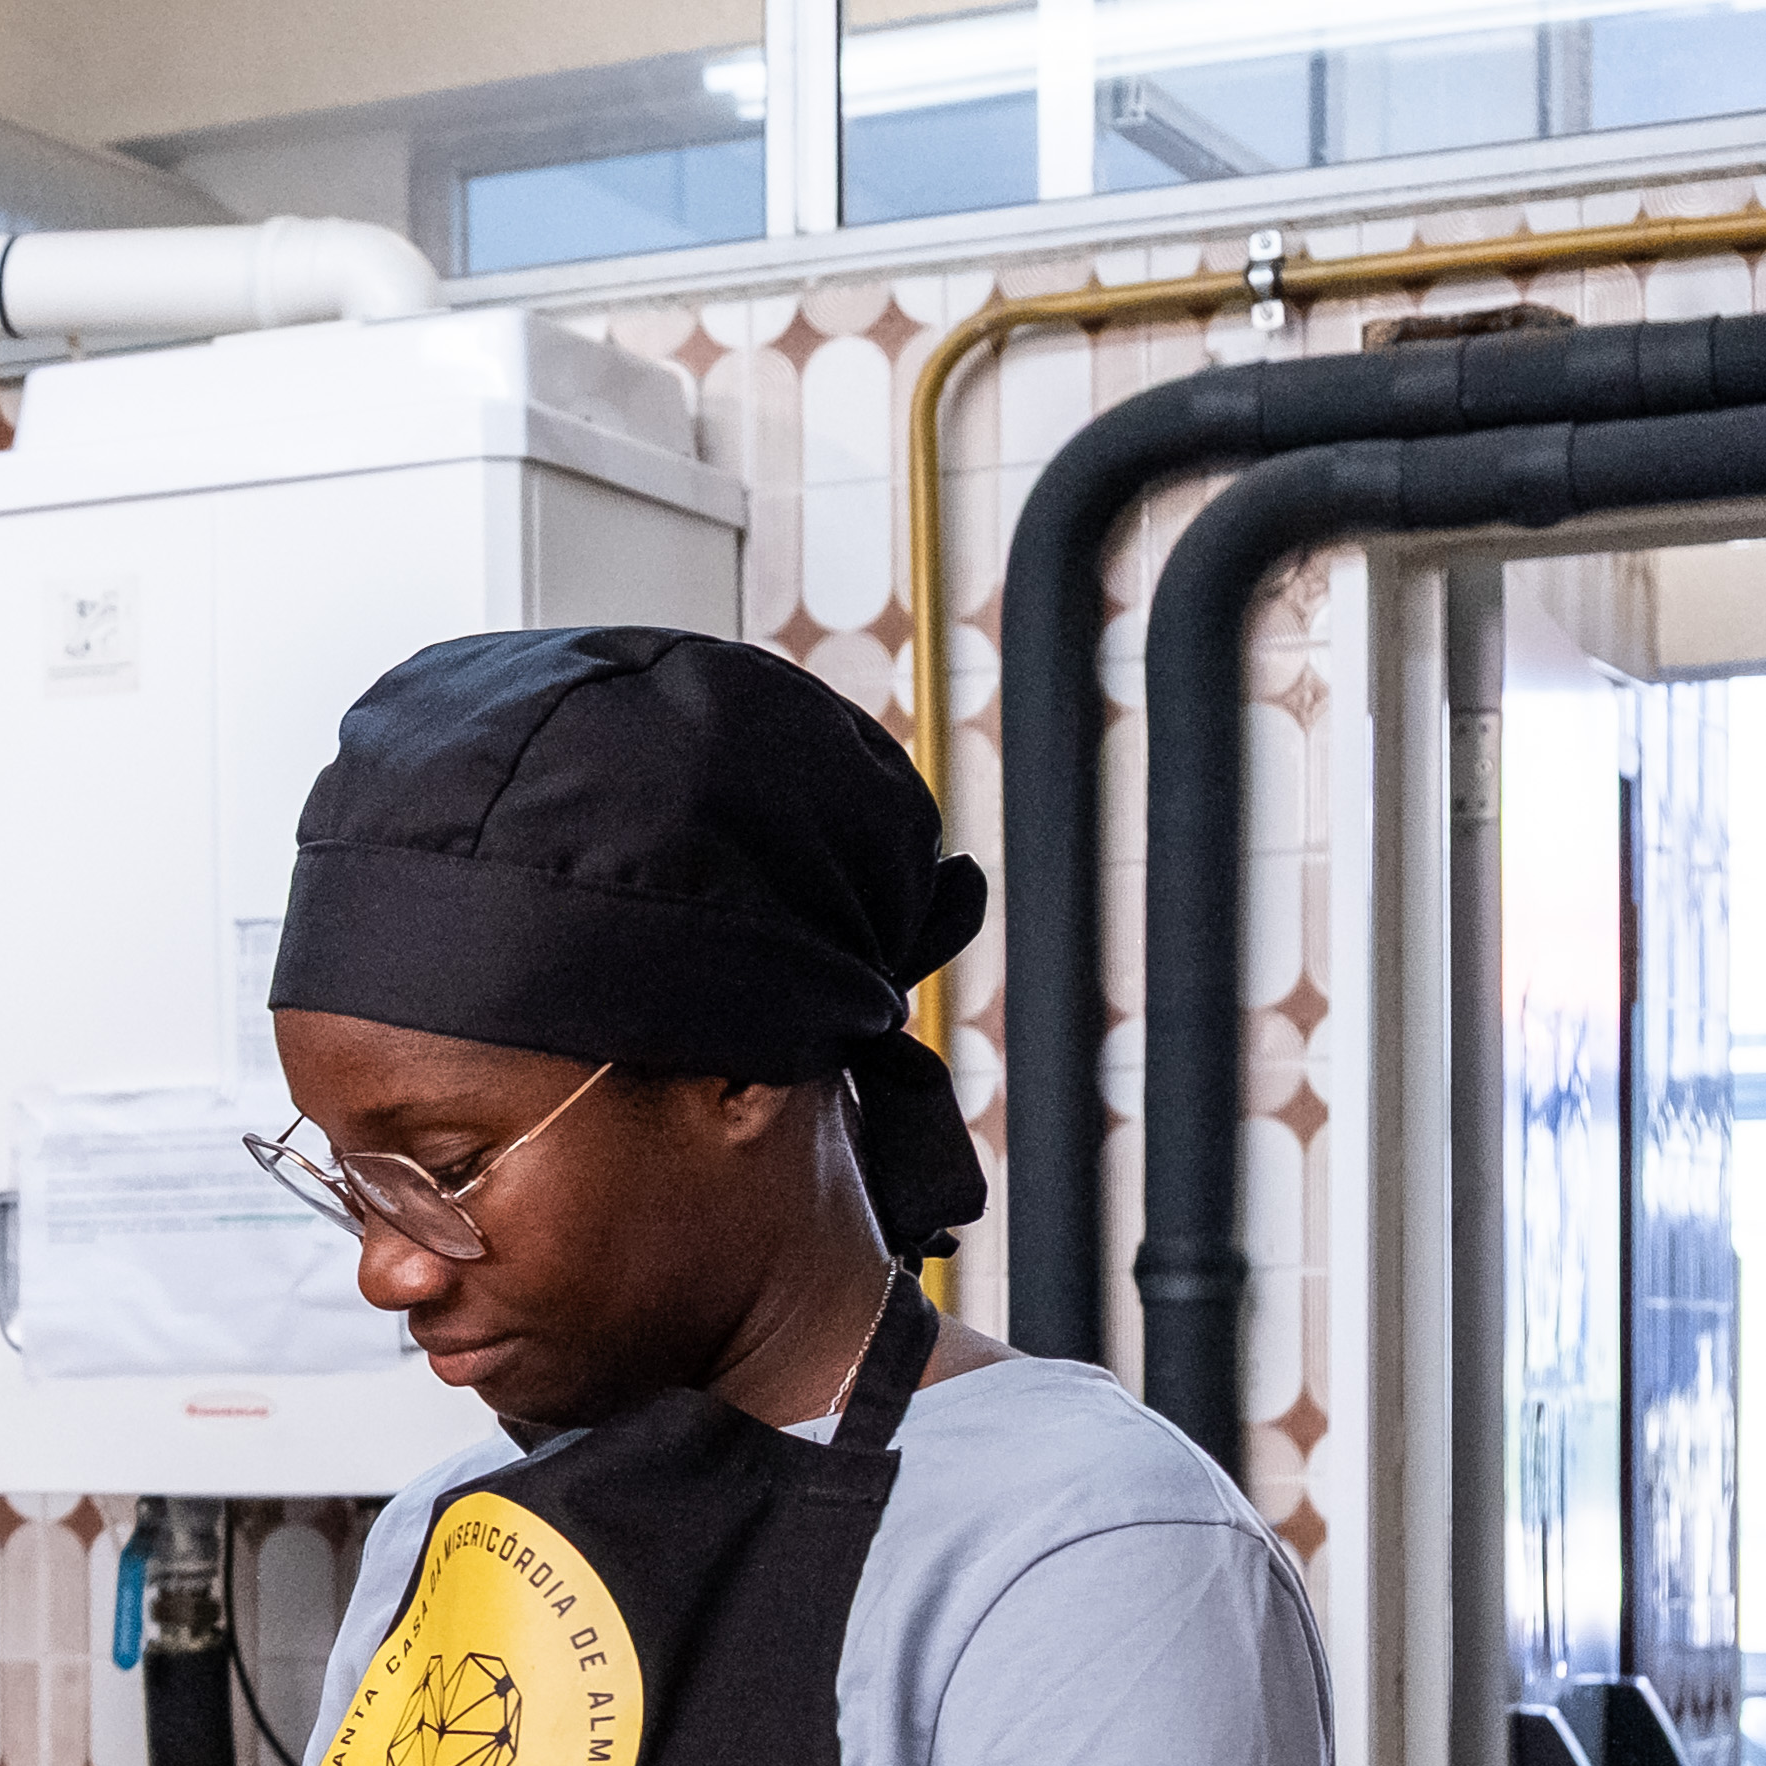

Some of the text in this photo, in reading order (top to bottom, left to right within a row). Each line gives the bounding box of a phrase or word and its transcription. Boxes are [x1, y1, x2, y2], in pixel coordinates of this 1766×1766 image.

[385, 1600, 429, 1676] CASA
[430, 1556, 443, 1596] DA
[443, 1520, 578, 1619] MISERICÓRDIA
[570, 1626, 608, 1672] DE
